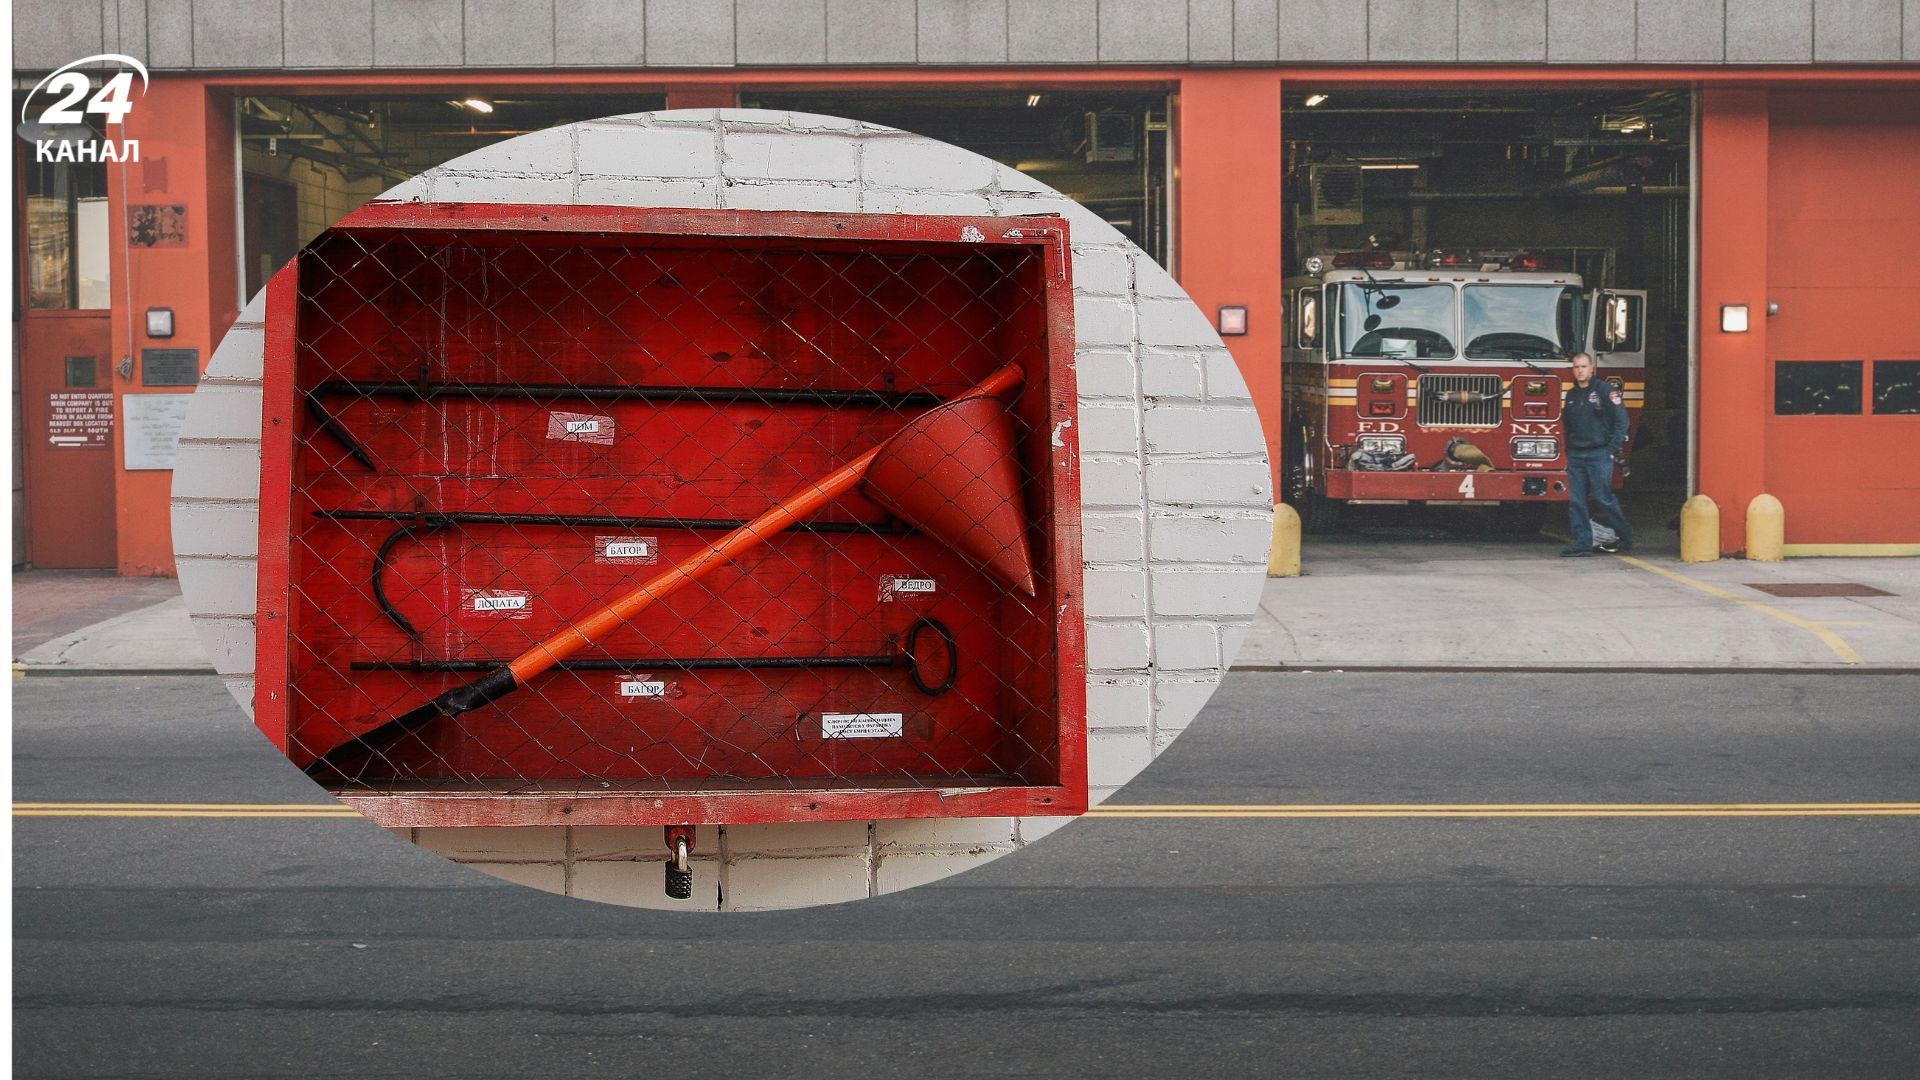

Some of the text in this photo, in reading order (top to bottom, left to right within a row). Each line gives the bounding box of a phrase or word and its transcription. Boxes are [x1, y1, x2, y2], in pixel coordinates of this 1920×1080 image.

[570, 423, 593, 431] ЛОМ
[1358, 421, 1560, 434] F.D. N.Y.
[1458, 475, 1475, 498] 4
[611, 547, 641, 555] БАГОР
[901, 581, 931, 590] ВЕДРО
[478, 600, 519, 608] ЛОПАТА
